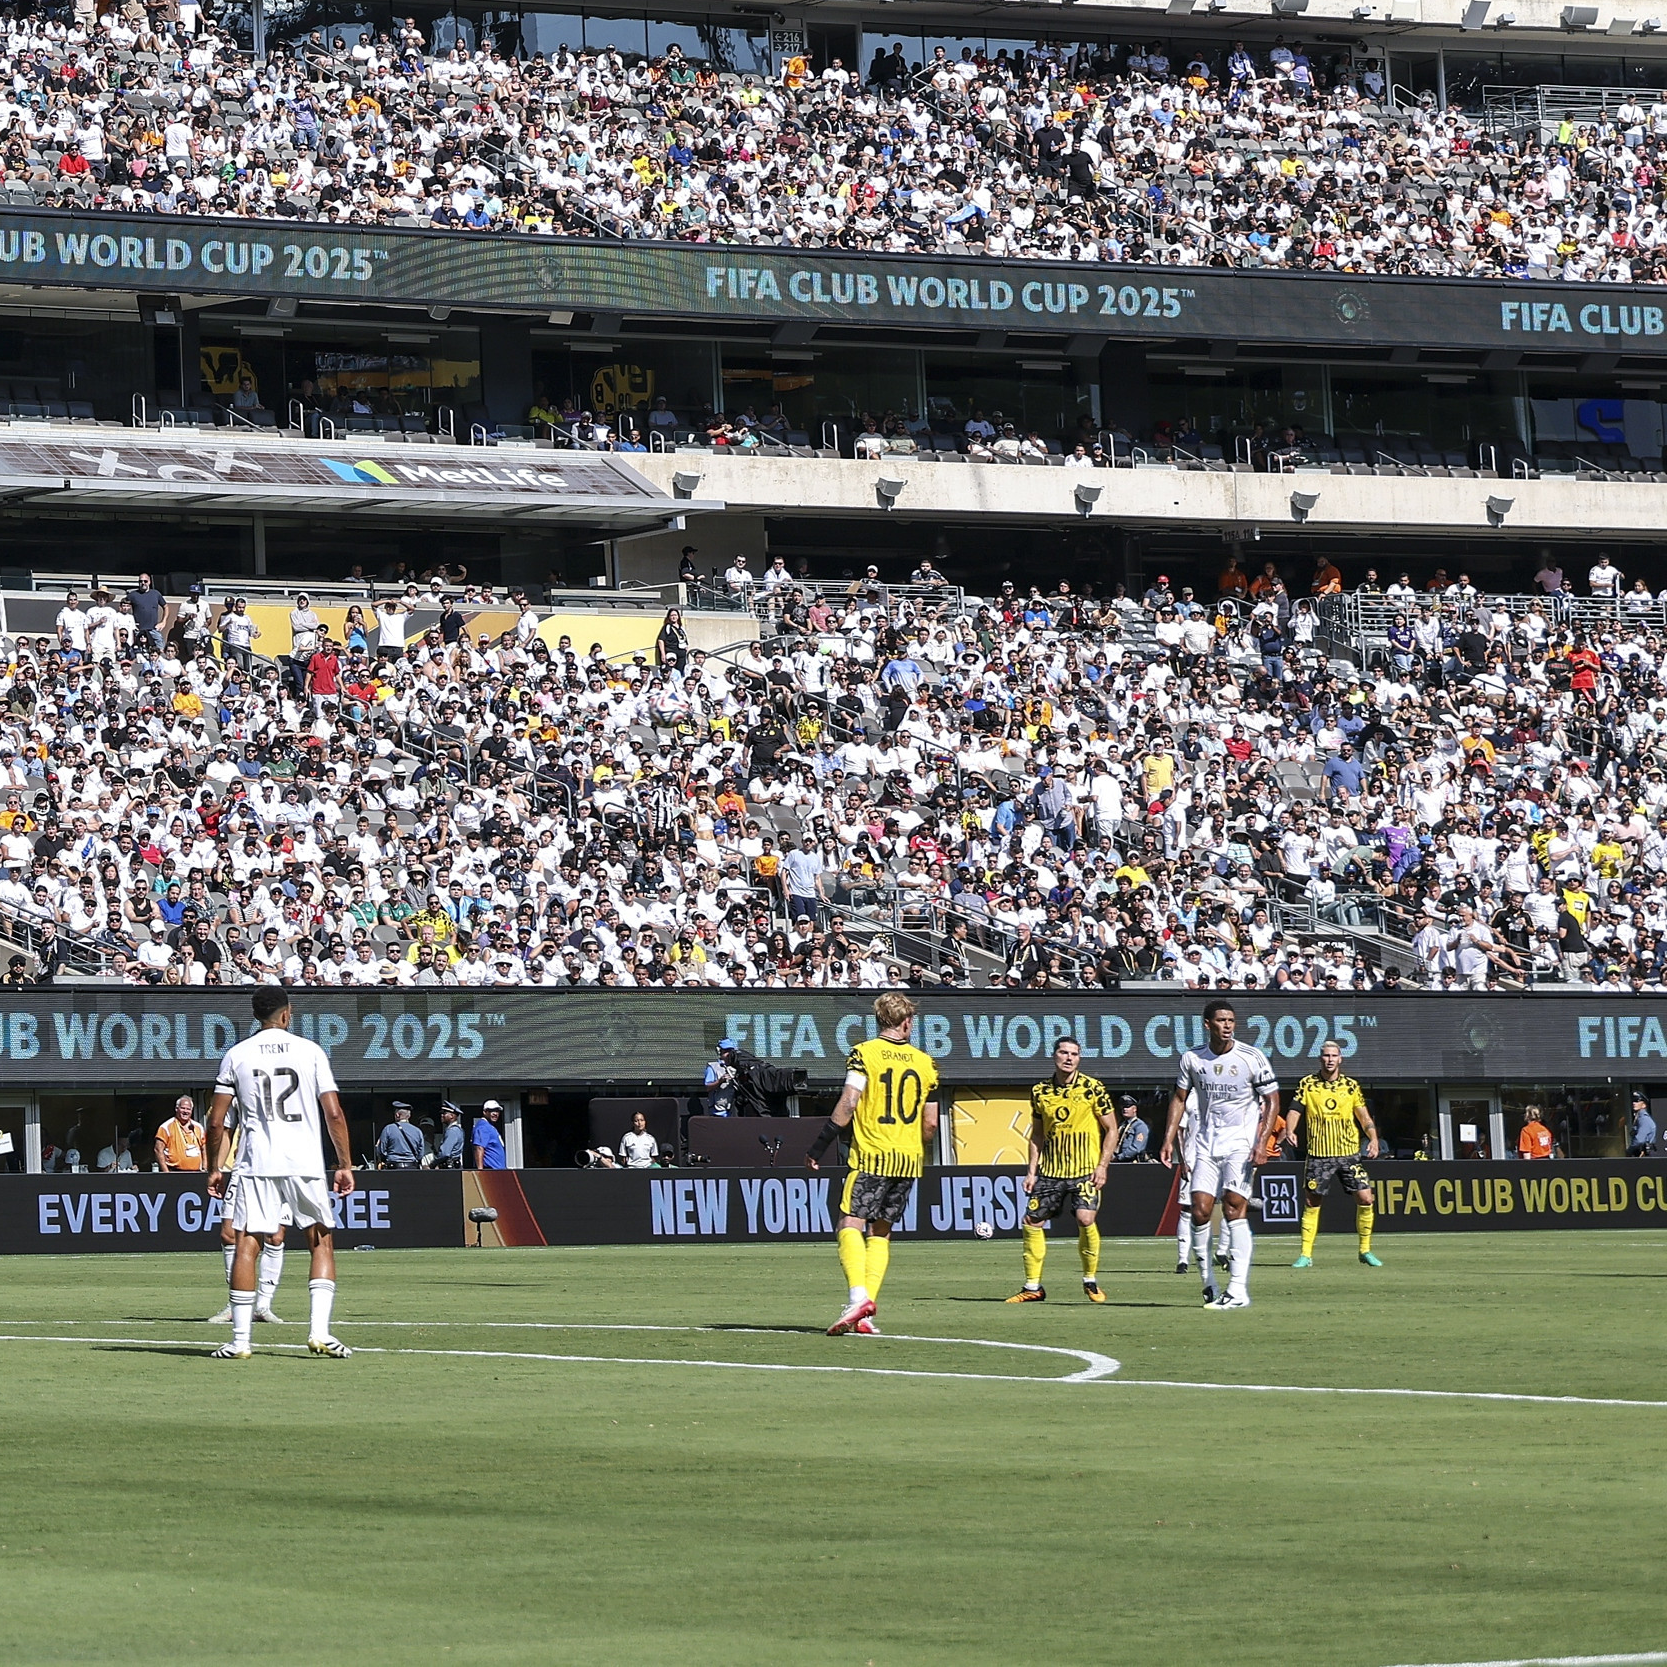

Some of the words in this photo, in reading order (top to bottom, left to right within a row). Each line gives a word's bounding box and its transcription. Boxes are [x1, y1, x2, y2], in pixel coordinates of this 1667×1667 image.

[56, 233, 192, 271] WORLD
[201, 240, 274, 276] CUP
[706, 266, 781, 301] FIFA
[788, 270, 879, 306] CLUB
[887, 276, 1013, 312] WORLD
[1021, 281, 1089, 314] CUP
[1501, 301, 1573, 333] FIFA
[1580, 303, 1665, 335] CLUB
[394, 464, 568, 487] MetLife
[53, 1010, 236, 1059] WORLD
[259, 1043, 290, 1054] TRENT
[726, 1014, 826, 1058] FIFA
[837, 1014, 952, 1058] CB
[964, 1014, 1131, 1058] WORLD
[1146, 1015, 1204, 1057] CU
[1578, 1016, 1667, 1057] FIFA
[882, 1050, 914, 1063] BRANDT
[253, 1067, 302, 1122] 12
[878, 1068, 922, 1124] 10
[650, 1179, 728, 1235] NEW
[739, 1179, 834, 1234] YORK
[1077, 1182, 1096, 1197] 20
[1434, 1179, 1513, 1214] CLUB
[1520, 1178, 1627, 1213] WORLD
[1636, 1176, 1667, 1212] CU
[38, 1193, 166, 1233] EVERY
[331, 1190, 390, 1228] REE
